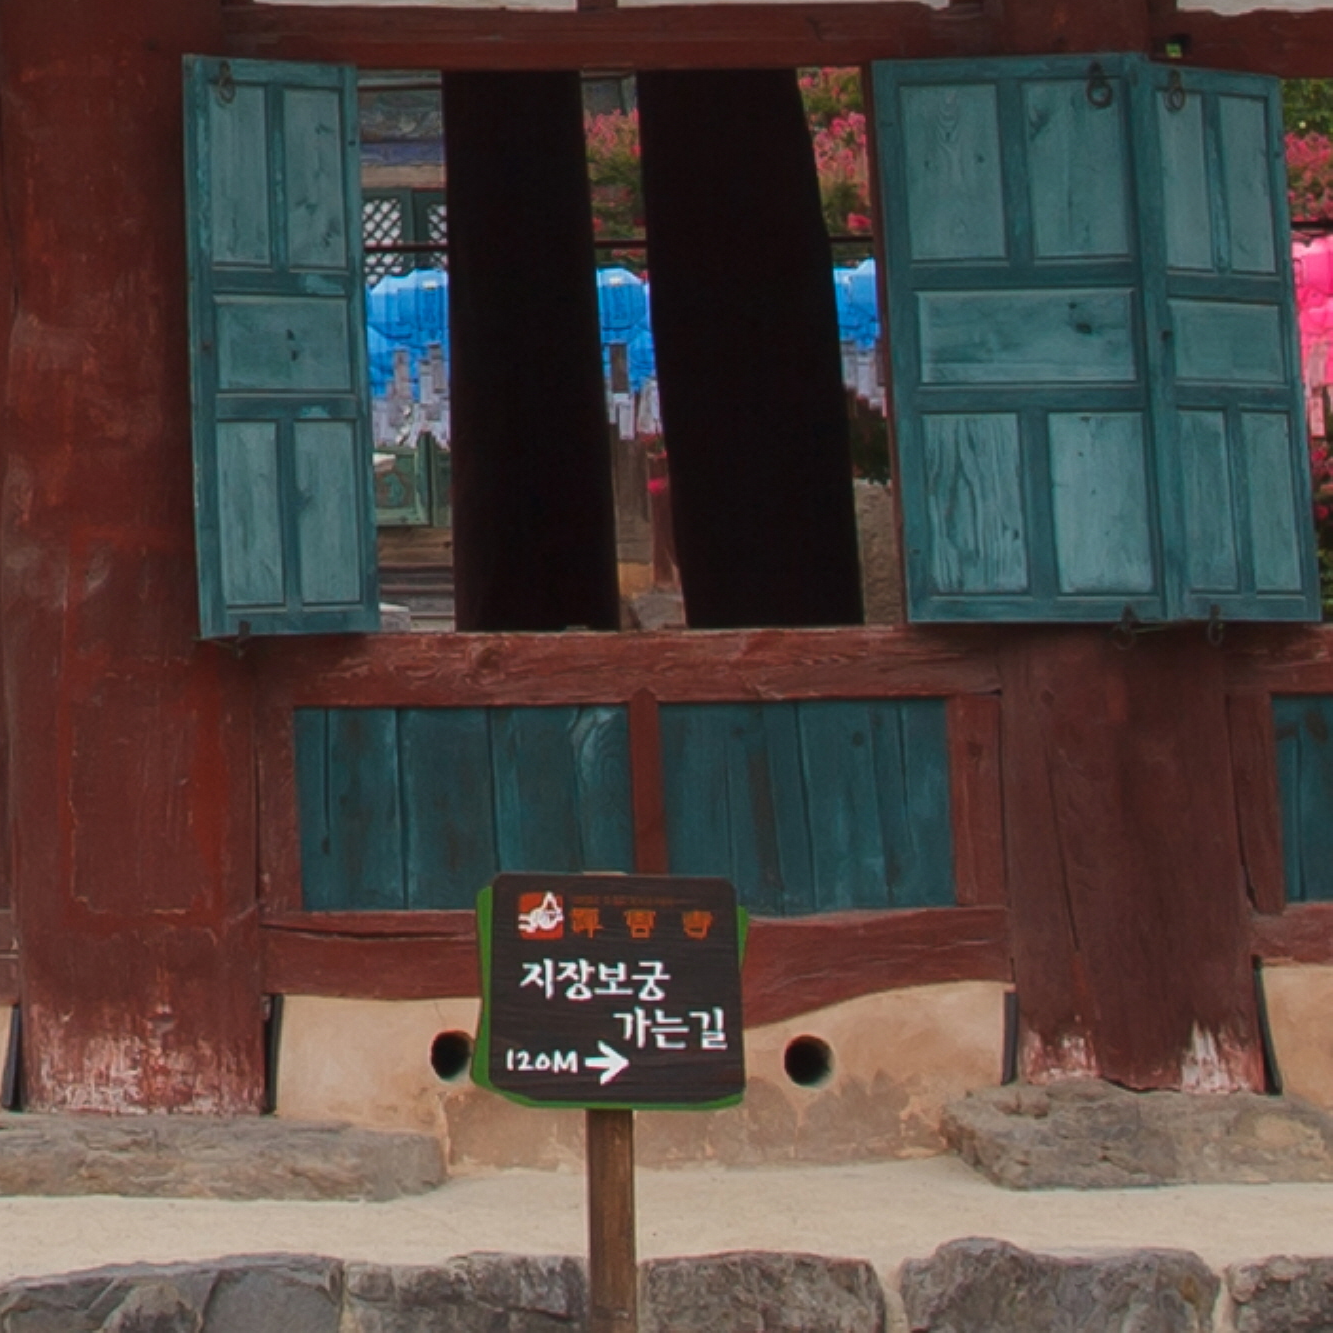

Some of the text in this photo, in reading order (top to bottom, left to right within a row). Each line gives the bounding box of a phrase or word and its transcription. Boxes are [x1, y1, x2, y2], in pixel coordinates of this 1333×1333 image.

[519, 958, 671, 1002] 지장보궁
[613, 1007, 728, 1050] 가는길
[505, 1048, 579, 1074] 120M
